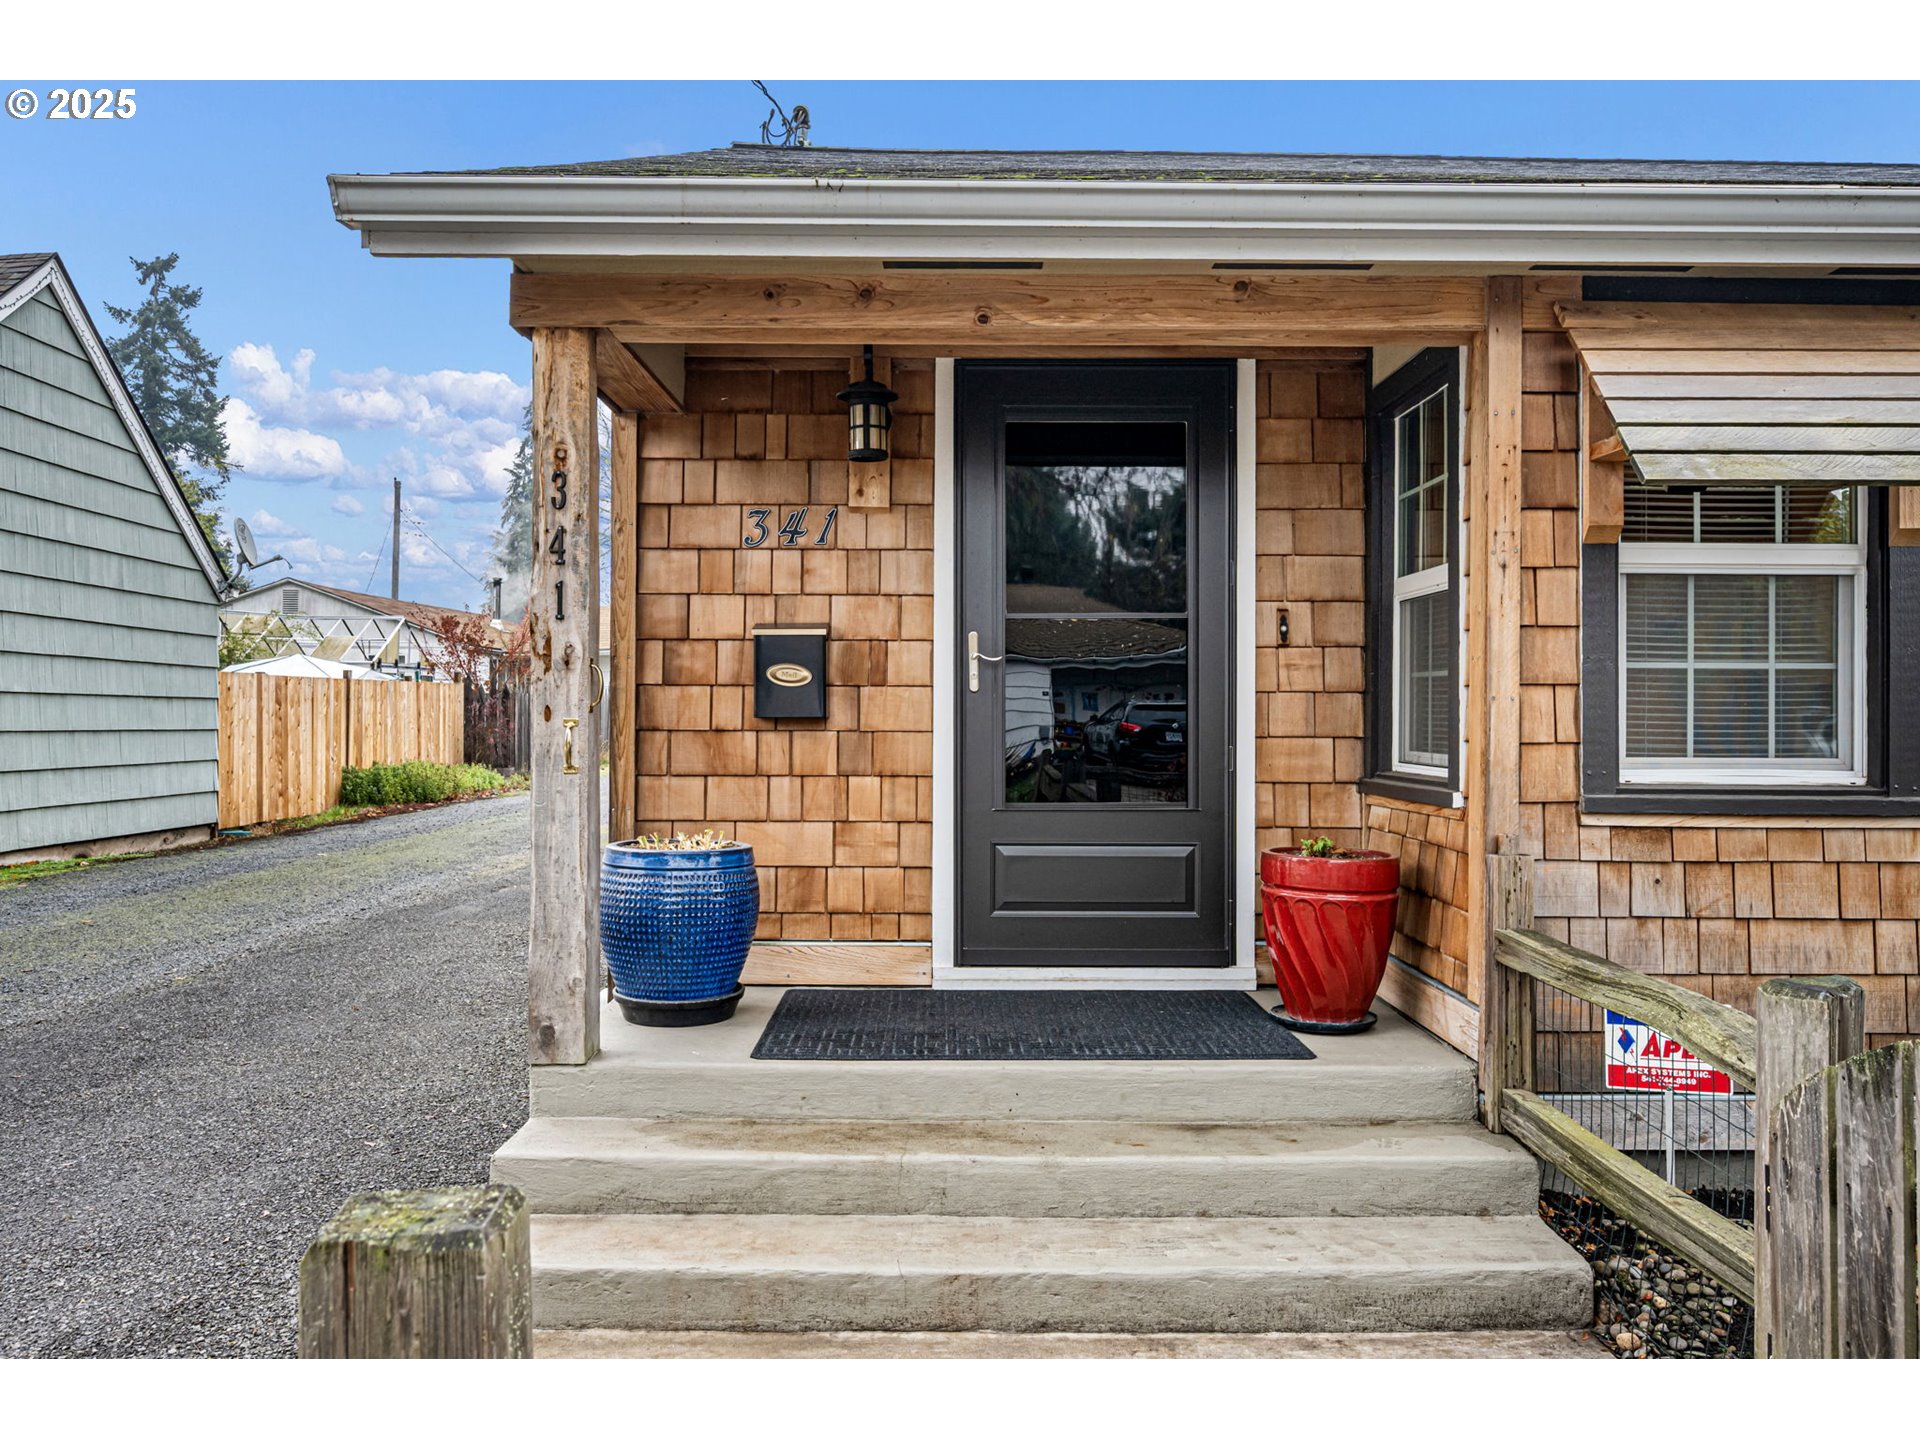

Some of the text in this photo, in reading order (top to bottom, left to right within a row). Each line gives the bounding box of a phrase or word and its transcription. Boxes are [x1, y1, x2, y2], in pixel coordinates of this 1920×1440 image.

[549, 470, 567, 621] 341
[743, 506, 837, 547] 341
[1651, 1068, 1692, 1078] SYSTEMS
